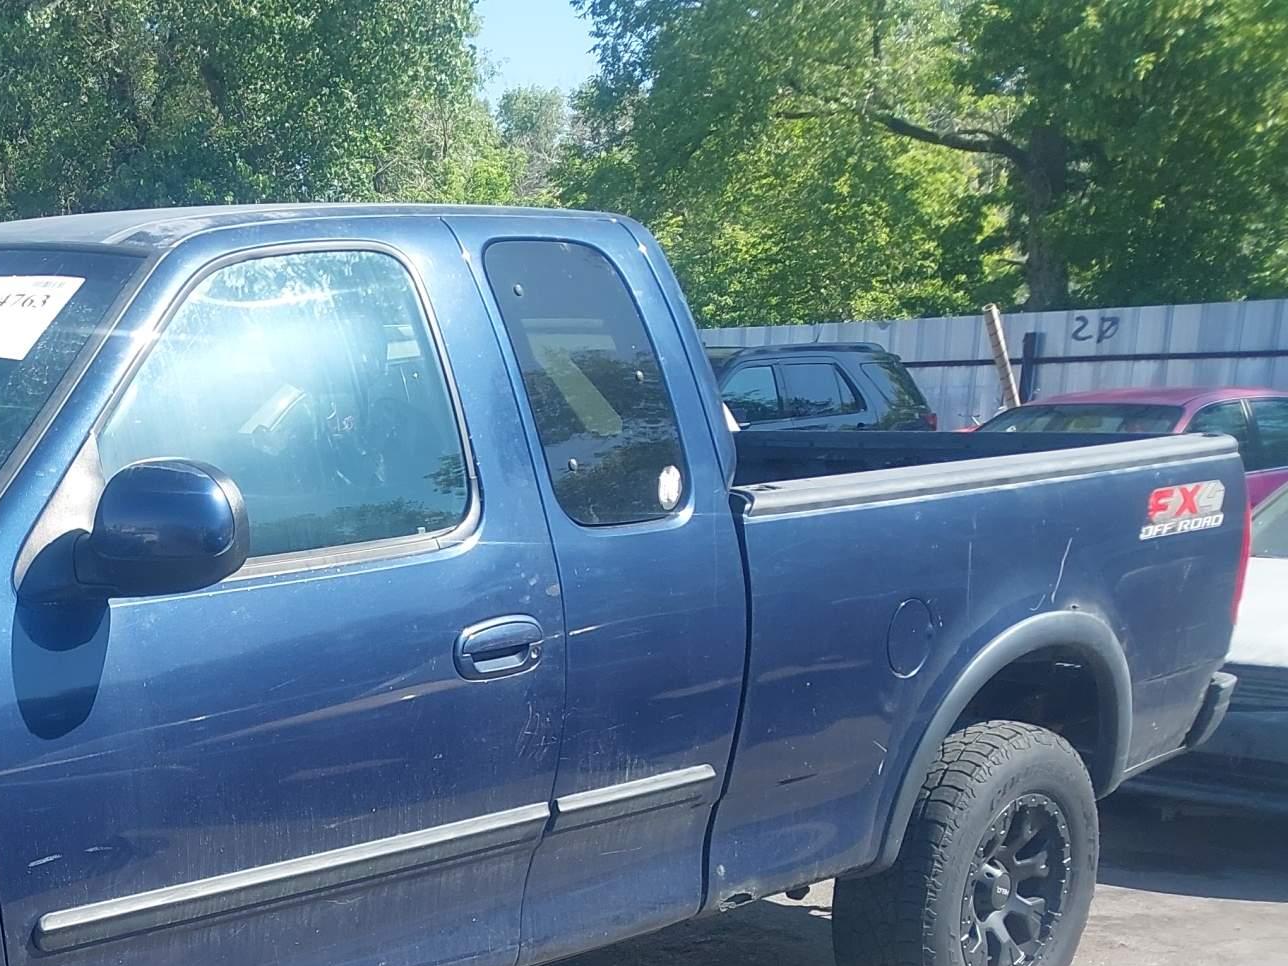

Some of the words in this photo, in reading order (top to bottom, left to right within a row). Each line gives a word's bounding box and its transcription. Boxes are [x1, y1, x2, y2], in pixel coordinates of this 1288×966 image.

[1147, 481, 1225, 519] FX4
[1140, 522, 1175, 540] OFF
[1177, 514, 1224, 533] ROAD
